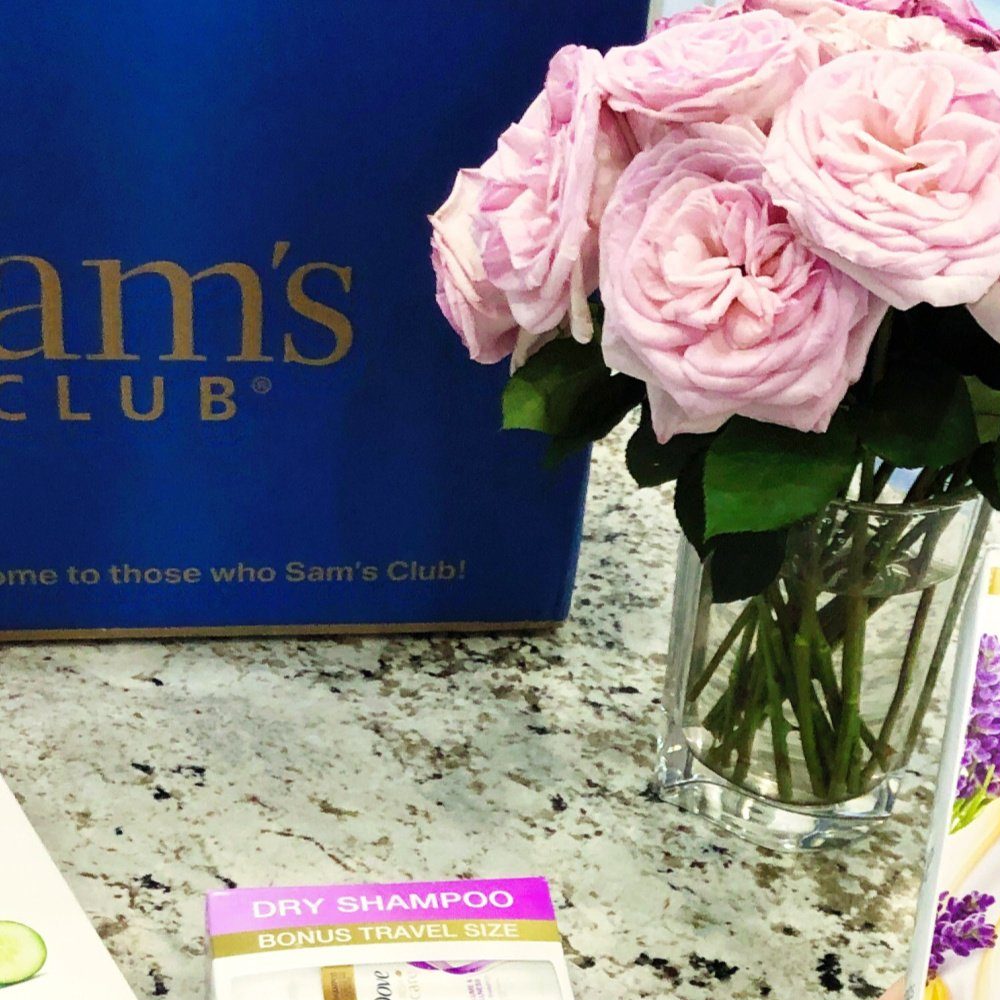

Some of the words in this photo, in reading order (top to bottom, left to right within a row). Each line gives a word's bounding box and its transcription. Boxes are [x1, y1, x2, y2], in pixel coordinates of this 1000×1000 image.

[66, 566, 100, 586] to
[110, 564, 202, 584] those
[210, 562, 277, 583] who
[285, 561, 379, 582] Sam's
[386, 560, 466, 581] Club!
[253, 898, 326, 919] DRY
[337, 890, 515, 913] SHAMPOO
[258, 928, 353, 949] BONUS
[358, 924, 459, 941] TRAVEL
[464, 922, 520, 938] SIZE
